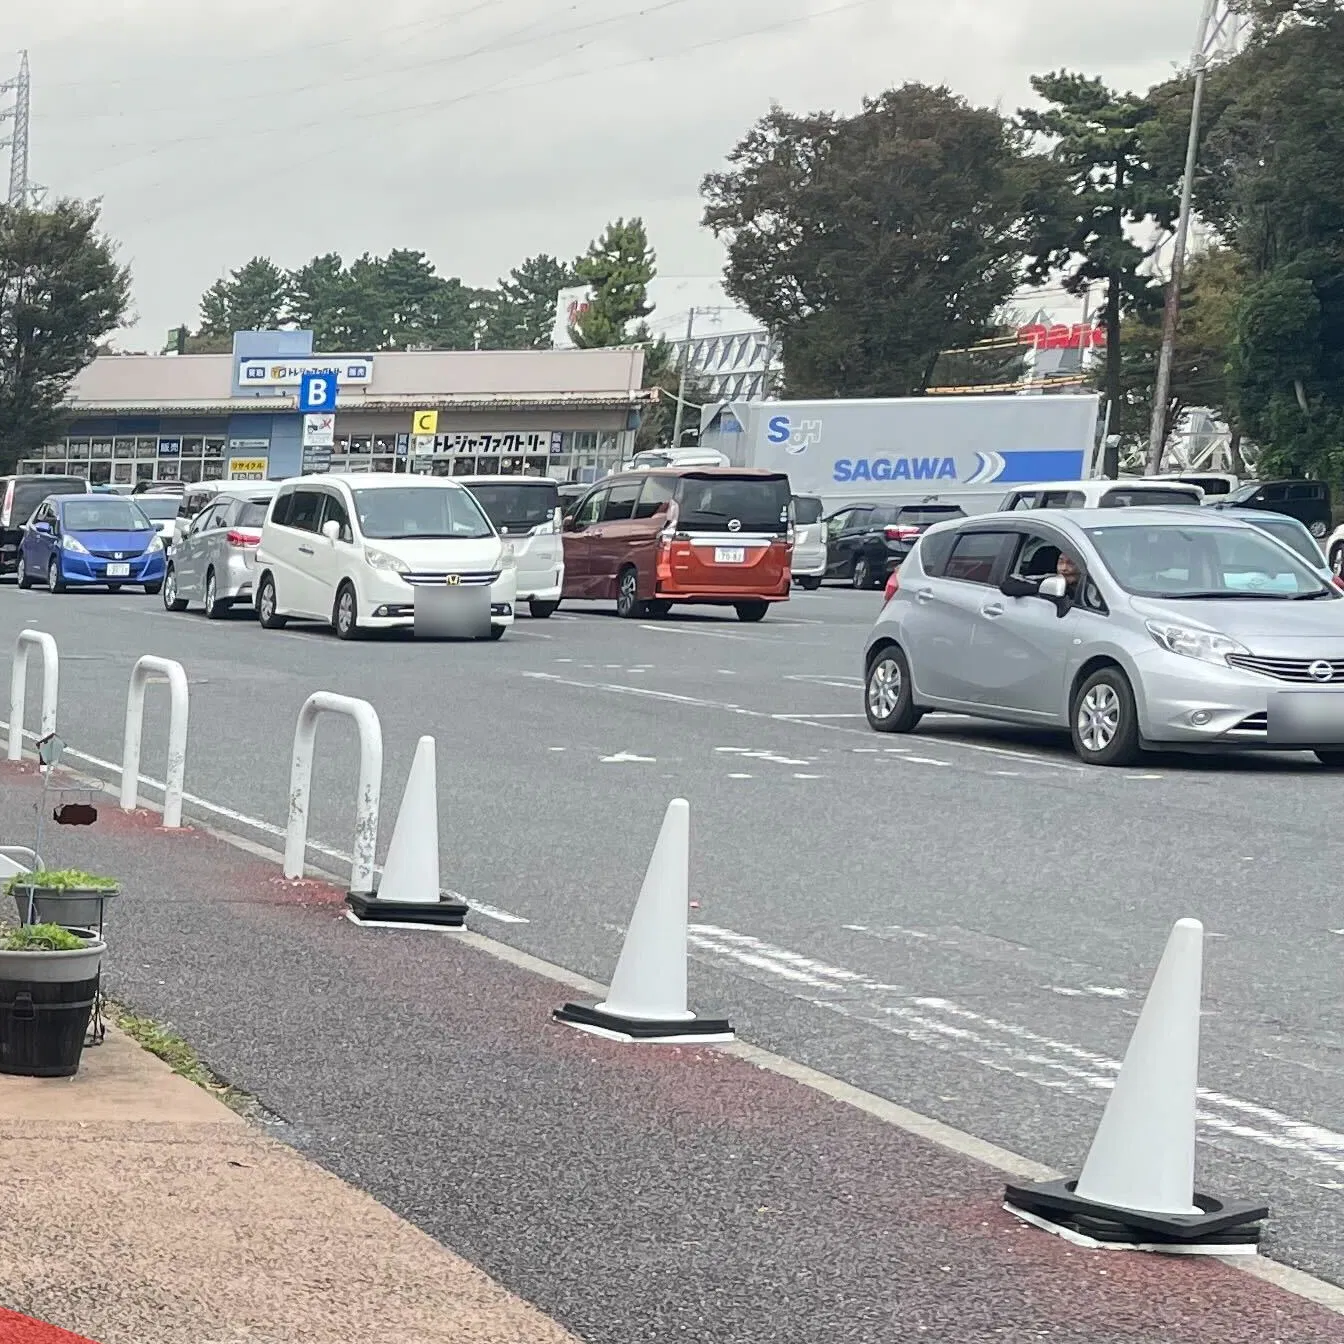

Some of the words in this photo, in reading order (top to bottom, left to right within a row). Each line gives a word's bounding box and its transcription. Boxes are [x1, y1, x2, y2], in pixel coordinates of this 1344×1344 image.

[308, 378, 328, 406] B
[419, 414, 432, 430] C
[832, 457, 957, 481] SAGAWA
